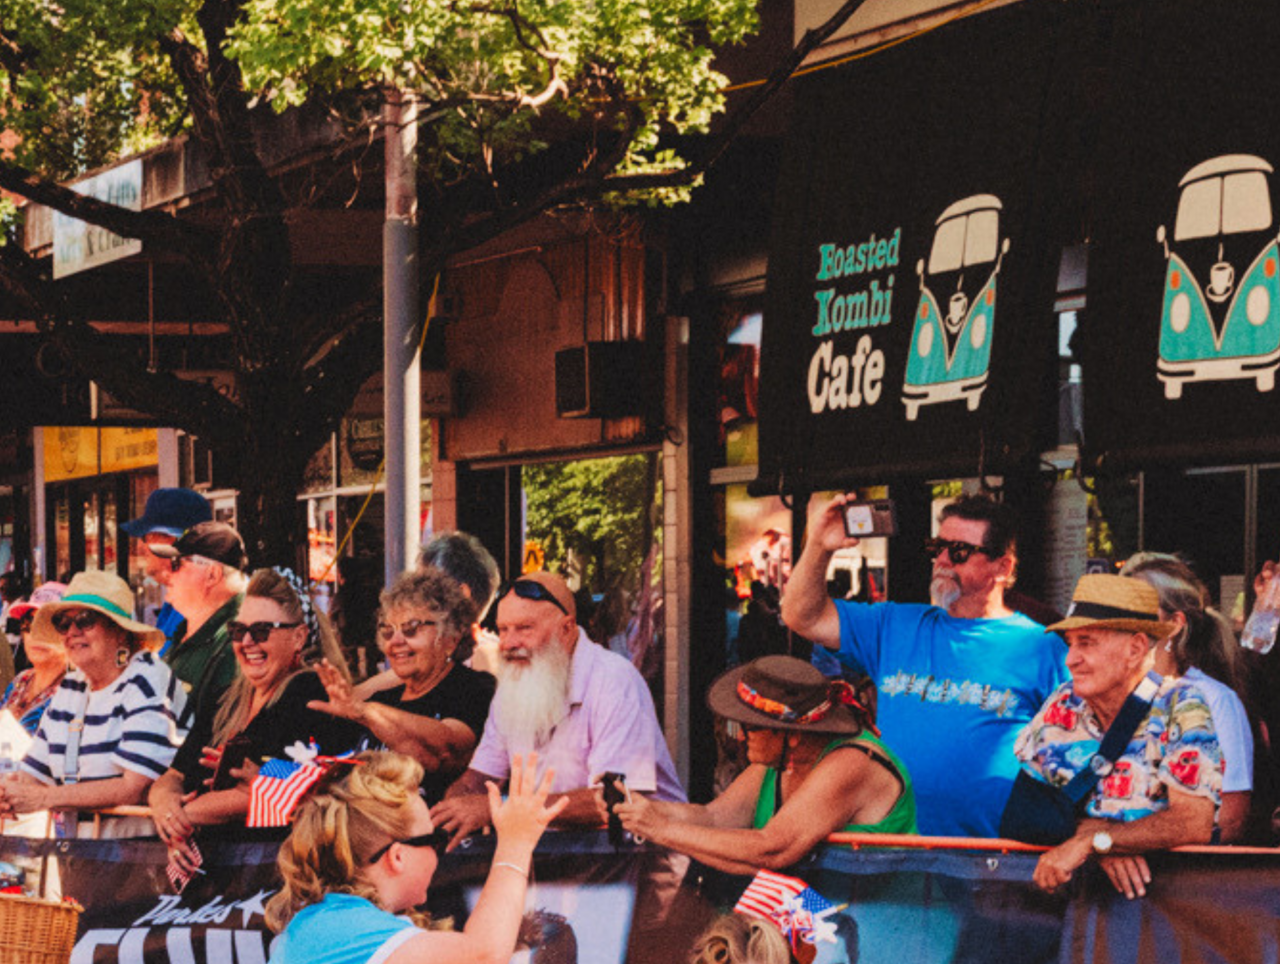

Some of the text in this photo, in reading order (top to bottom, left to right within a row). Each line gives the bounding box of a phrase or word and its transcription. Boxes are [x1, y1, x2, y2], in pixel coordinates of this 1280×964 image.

[812, 274, 895, 336] Kombi
[807, 334, 885, 413] Cafe
[132, 894, 241, 926] Parkes
